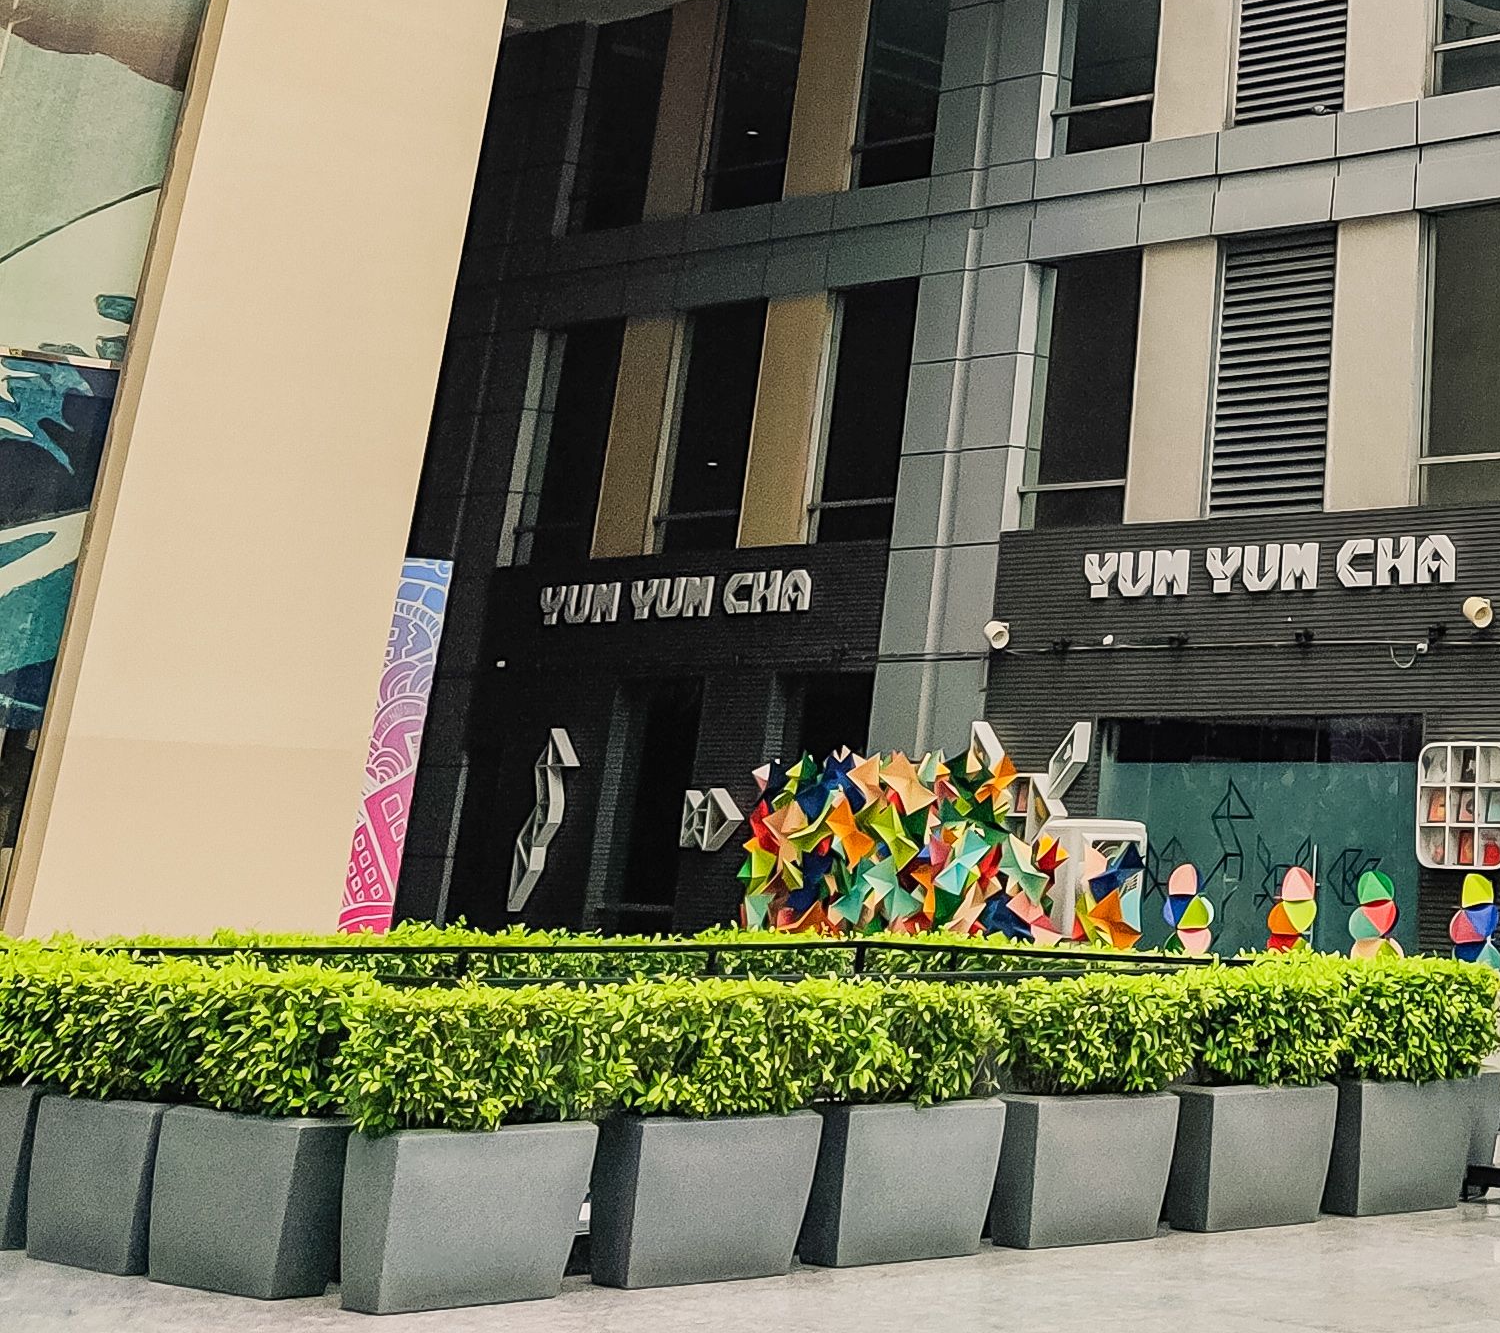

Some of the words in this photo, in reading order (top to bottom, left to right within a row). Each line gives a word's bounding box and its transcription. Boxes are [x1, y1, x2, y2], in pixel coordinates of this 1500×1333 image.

[540, 581, 622, 626] YUM
[630, 575, 716, 621] YUM
[722, 568, 813, 615] CHA
[1083, 549, 1191, 599] YUM
[1205, 542, 1320, 595] YUM
[1335, 534, 1457, 588] CHA
